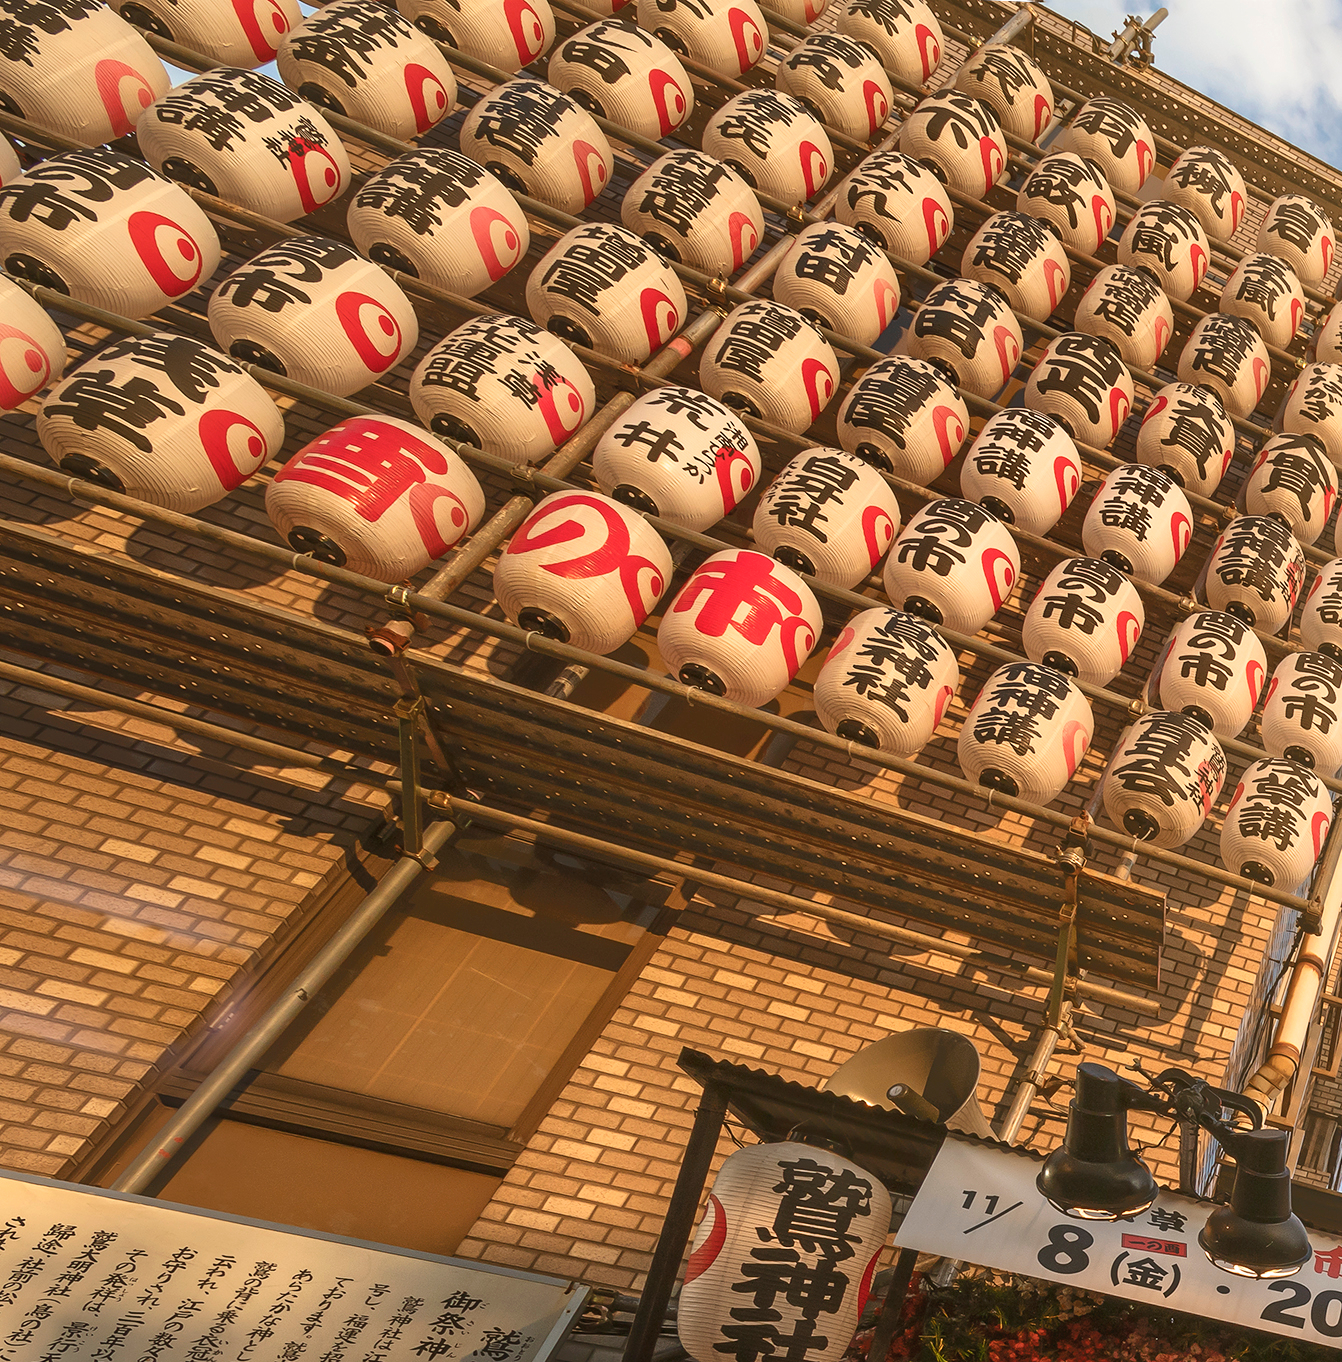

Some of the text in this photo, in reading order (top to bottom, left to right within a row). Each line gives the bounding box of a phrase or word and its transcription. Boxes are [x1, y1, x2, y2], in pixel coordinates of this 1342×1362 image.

[266, 117, 328, 170] 鷲神社
[218, 235, 360, 313] 酉の市
[542, 222, 650, 316] 増田屋
[793, 228, 862, 296] 村田
[712, 300, 805, 384] 増田屋
[908, 280, 990, 357] 村田
[44, 330, 240, 455] 浅草
[495, 350, 570, 410] 浅草
[843, 356, 951, 445] 増田屋
[290, 412, 450, 524] 酉
[975, 408, 1062, 491] 福神講
[897, 500, 992, 576] 酉の市
[1097, 462, 1173, 544] 福神講
[673, 552, 804, 646] 市
[1040, 556, 1121, 635] 酉の市
[1212, 514, 1291, 604] 福神講
[843, 606, 948, 723] 鷲神社
[1178, 610, 1245, 692] 酉の市
[974, 660, 1074, 757] 福神講
[1124, 1236, 1183, 1256] 一の酉
[408, 1288, 487, 1362] 御祭神
